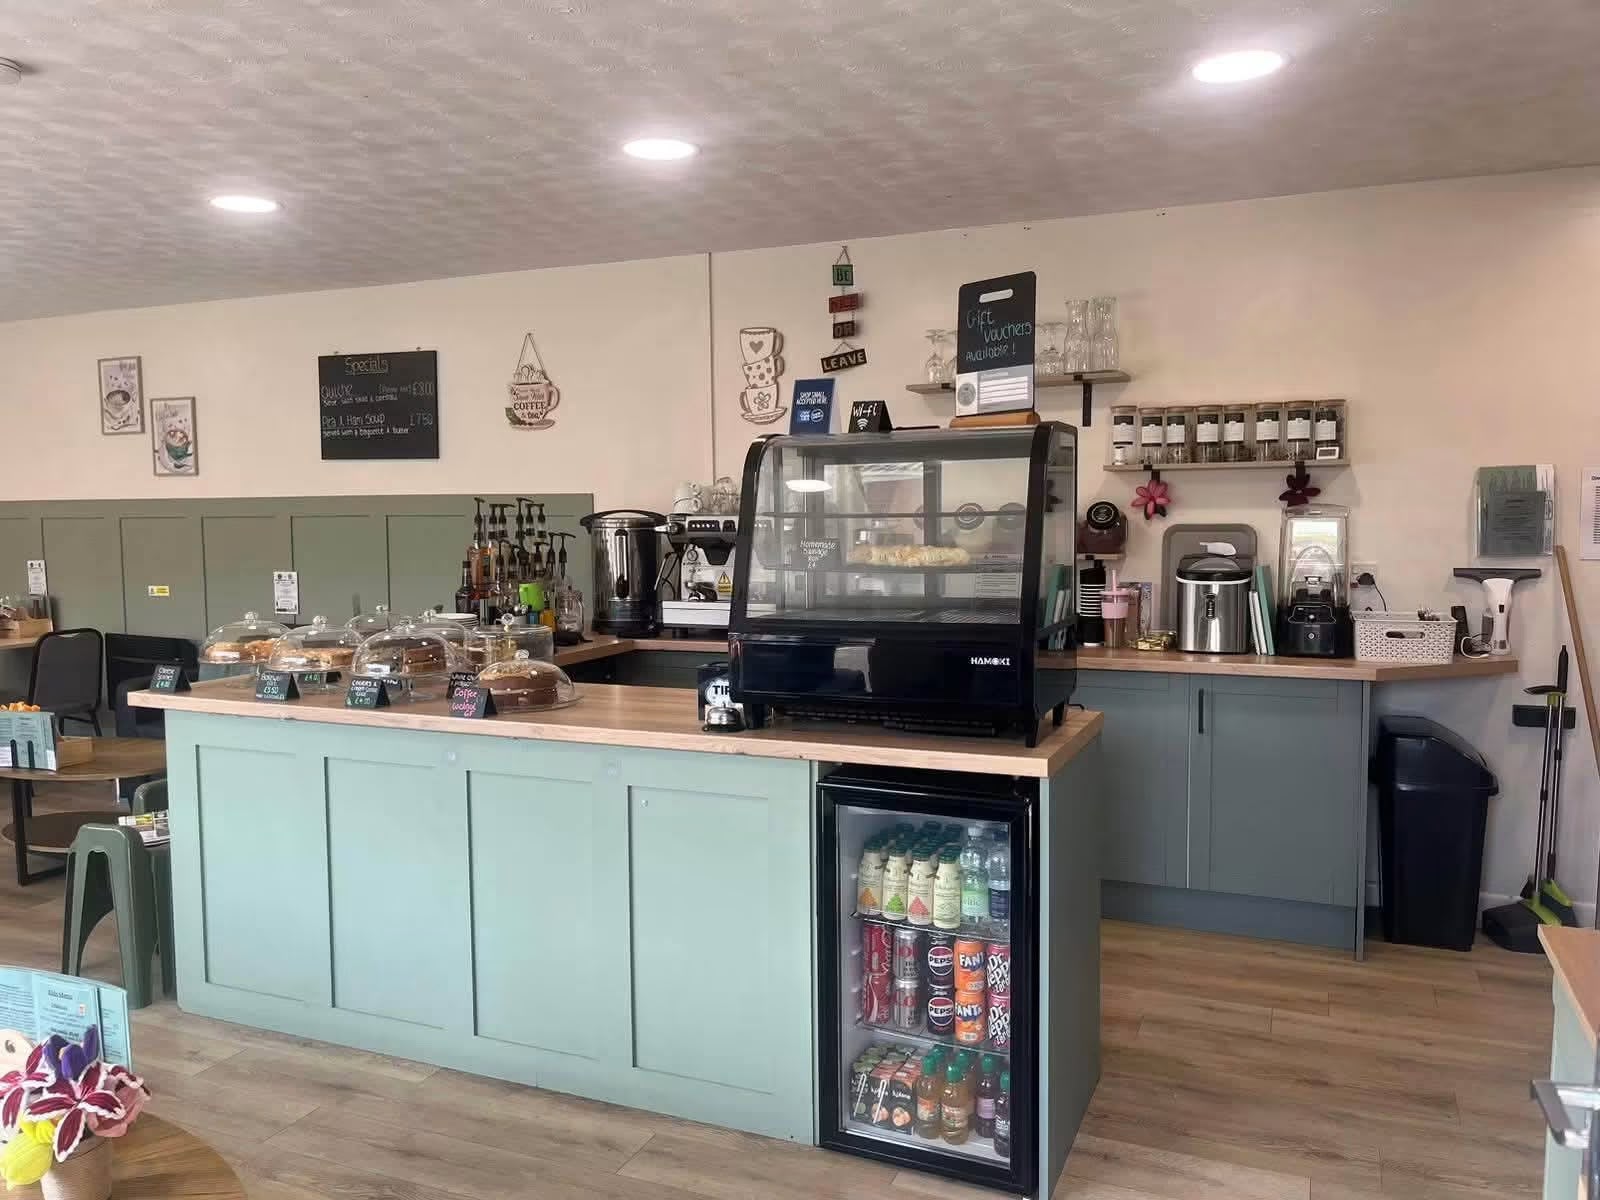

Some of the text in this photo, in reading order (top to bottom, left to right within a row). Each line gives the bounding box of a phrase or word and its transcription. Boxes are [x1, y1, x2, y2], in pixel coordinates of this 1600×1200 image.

[966, 308, 994, 332] Gift
[344, 355, 389, 374] Specials
[822, 350, 865, 371] LEAVE
[513, 401, 546, 411] COFFEE
[970, 657, 1010, 666] HAMOKI
[454, 687, 478, 699] Coffee
[929, 957, 953, 965] PEPS
[988, 954, 1003, 971] Dr
[956, 1002, 983, 1017] ANT
